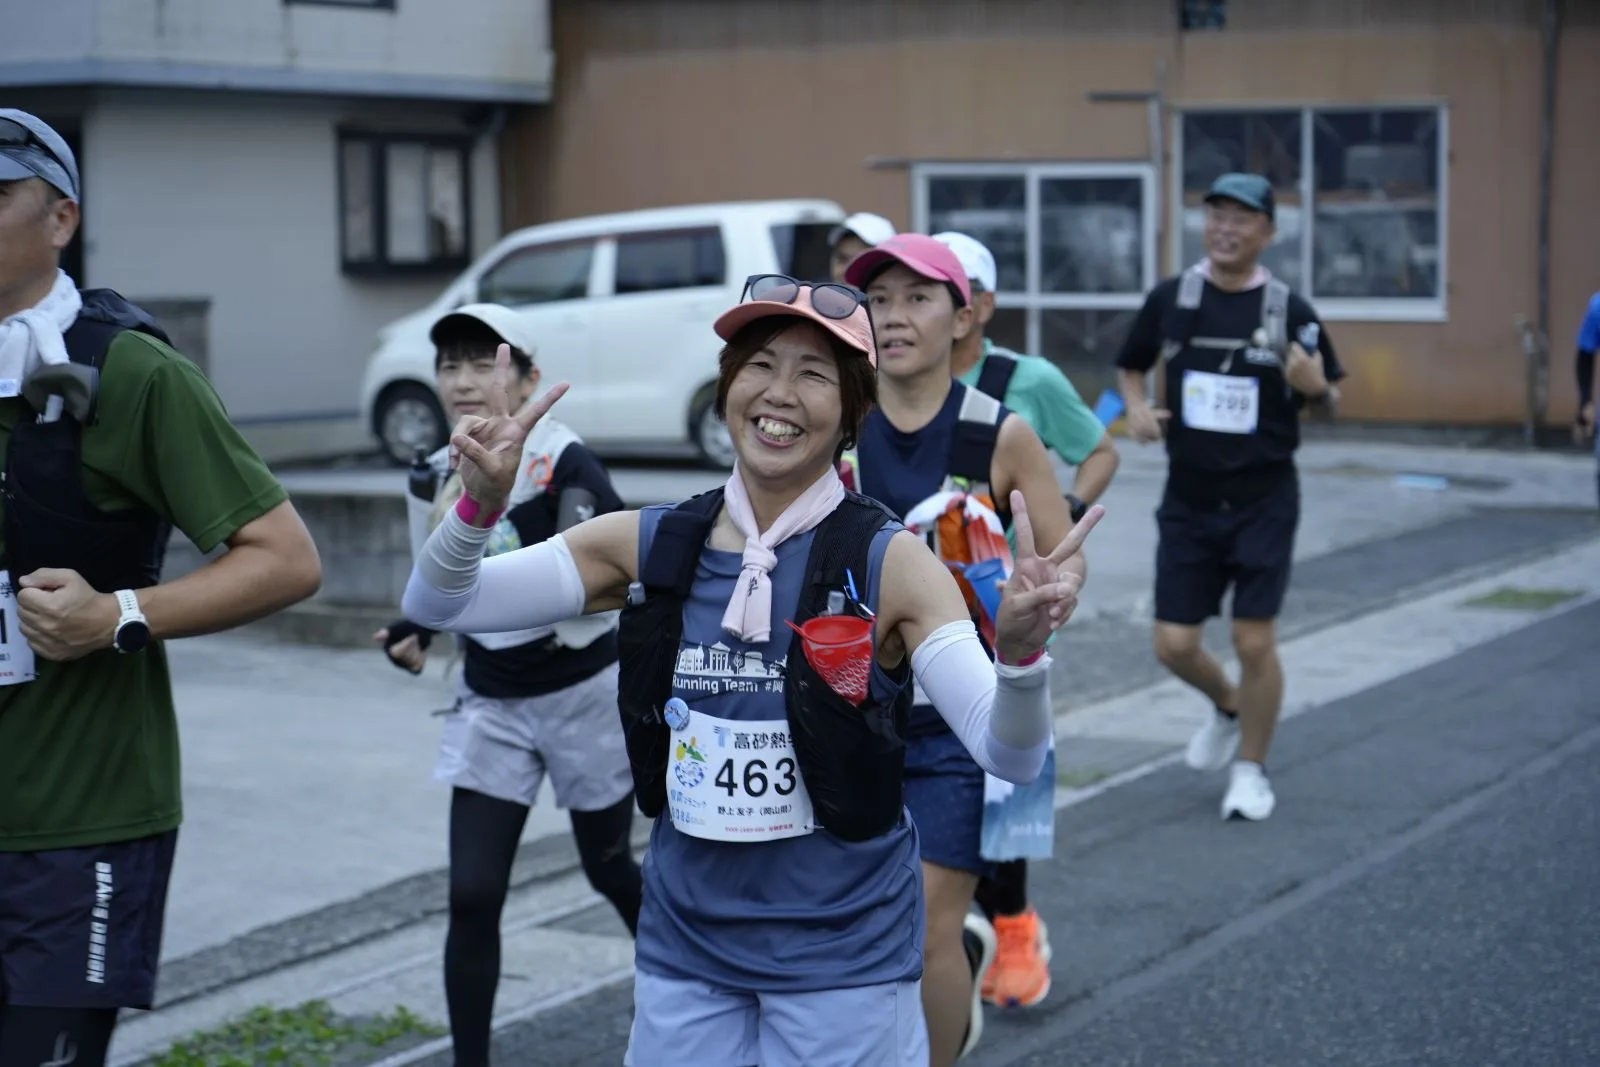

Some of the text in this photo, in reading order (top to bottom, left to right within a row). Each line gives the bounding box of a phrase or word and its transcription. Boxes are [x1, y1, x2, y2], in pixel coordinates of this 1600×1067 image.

[672, 674, 719, 694] Running
[722, 678, 758, 693] Team
[714, 757, 797, 798] 463
[86, 921, 108, 984] DESIGN
